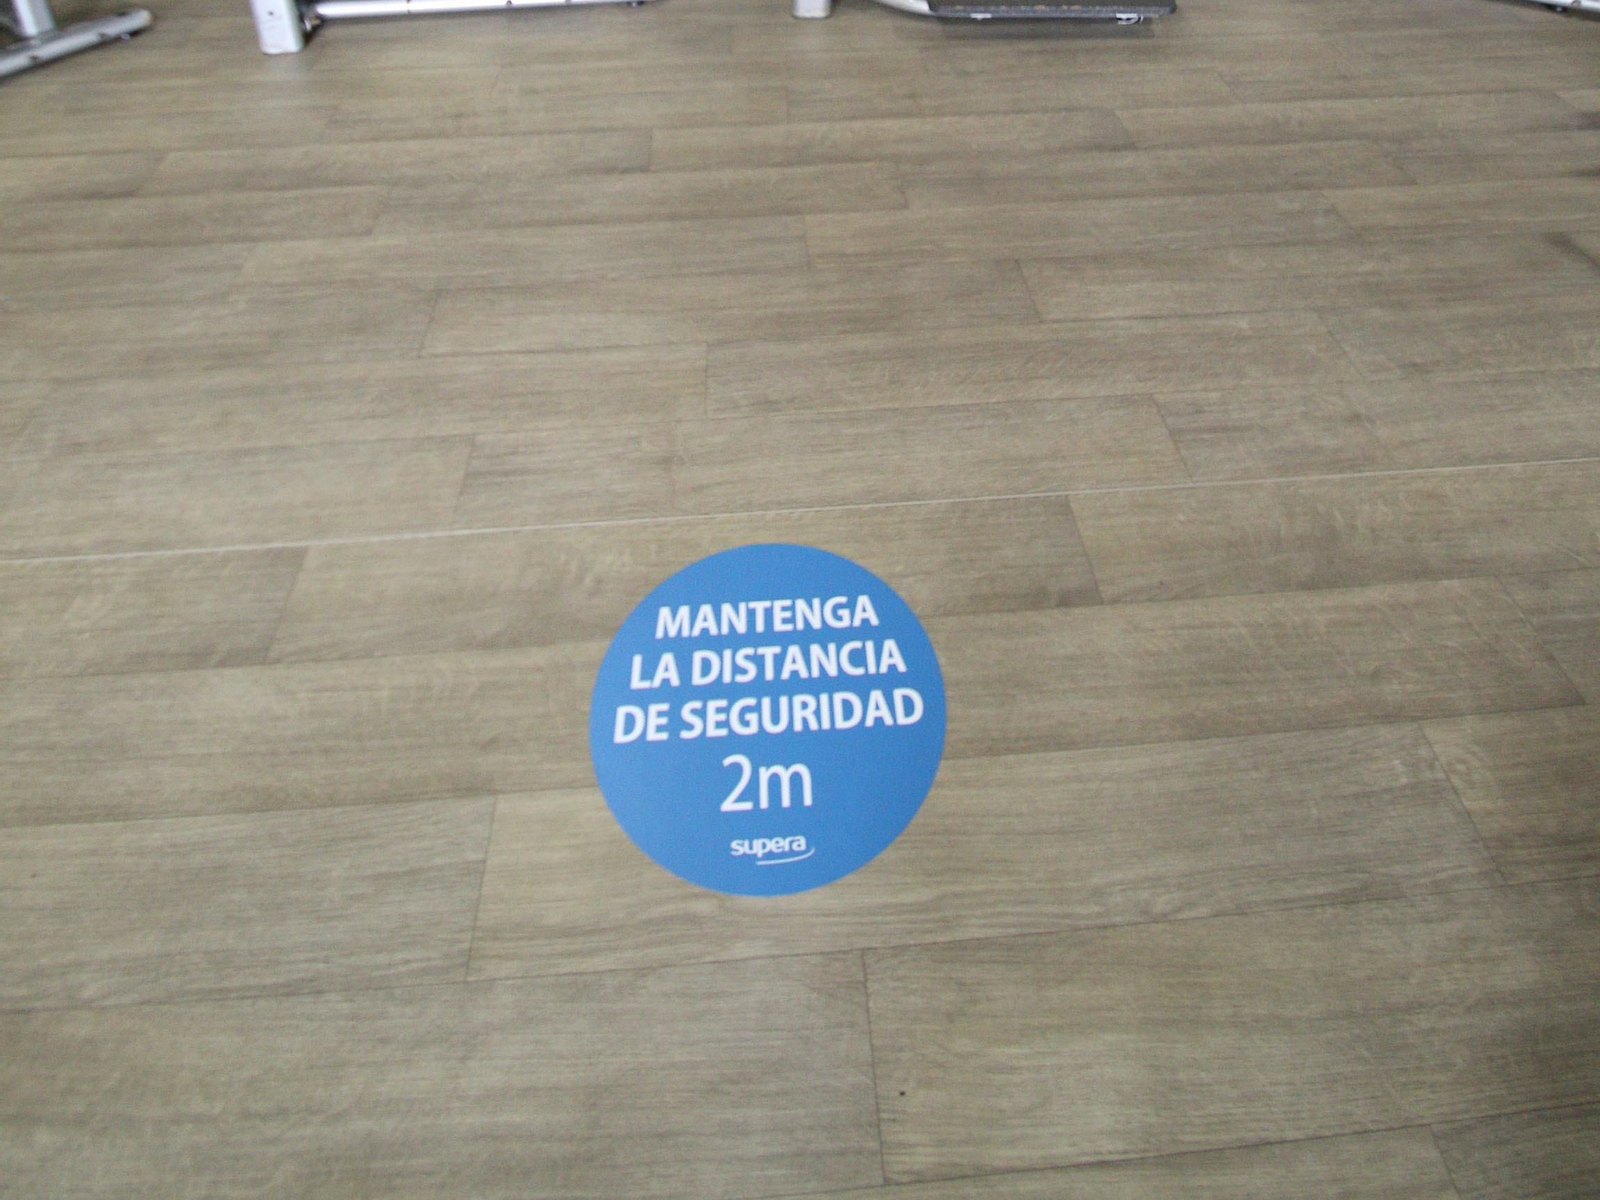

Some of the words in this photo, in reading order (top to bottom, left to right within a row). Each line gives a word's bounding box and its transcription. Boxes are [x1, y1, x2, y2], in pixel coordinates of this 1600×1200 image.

[655, 594, 880, 639] MANTENGA
[629, 652, 681, 690] LA
[691, 638, 907, 686] DISTANCIA
[613, 702, 671, 744] DE
[679, 687, 924, 740] SEGURIDAD
[720, 753, 813, 812] 2m
[730, 835, 807, 858] supera
